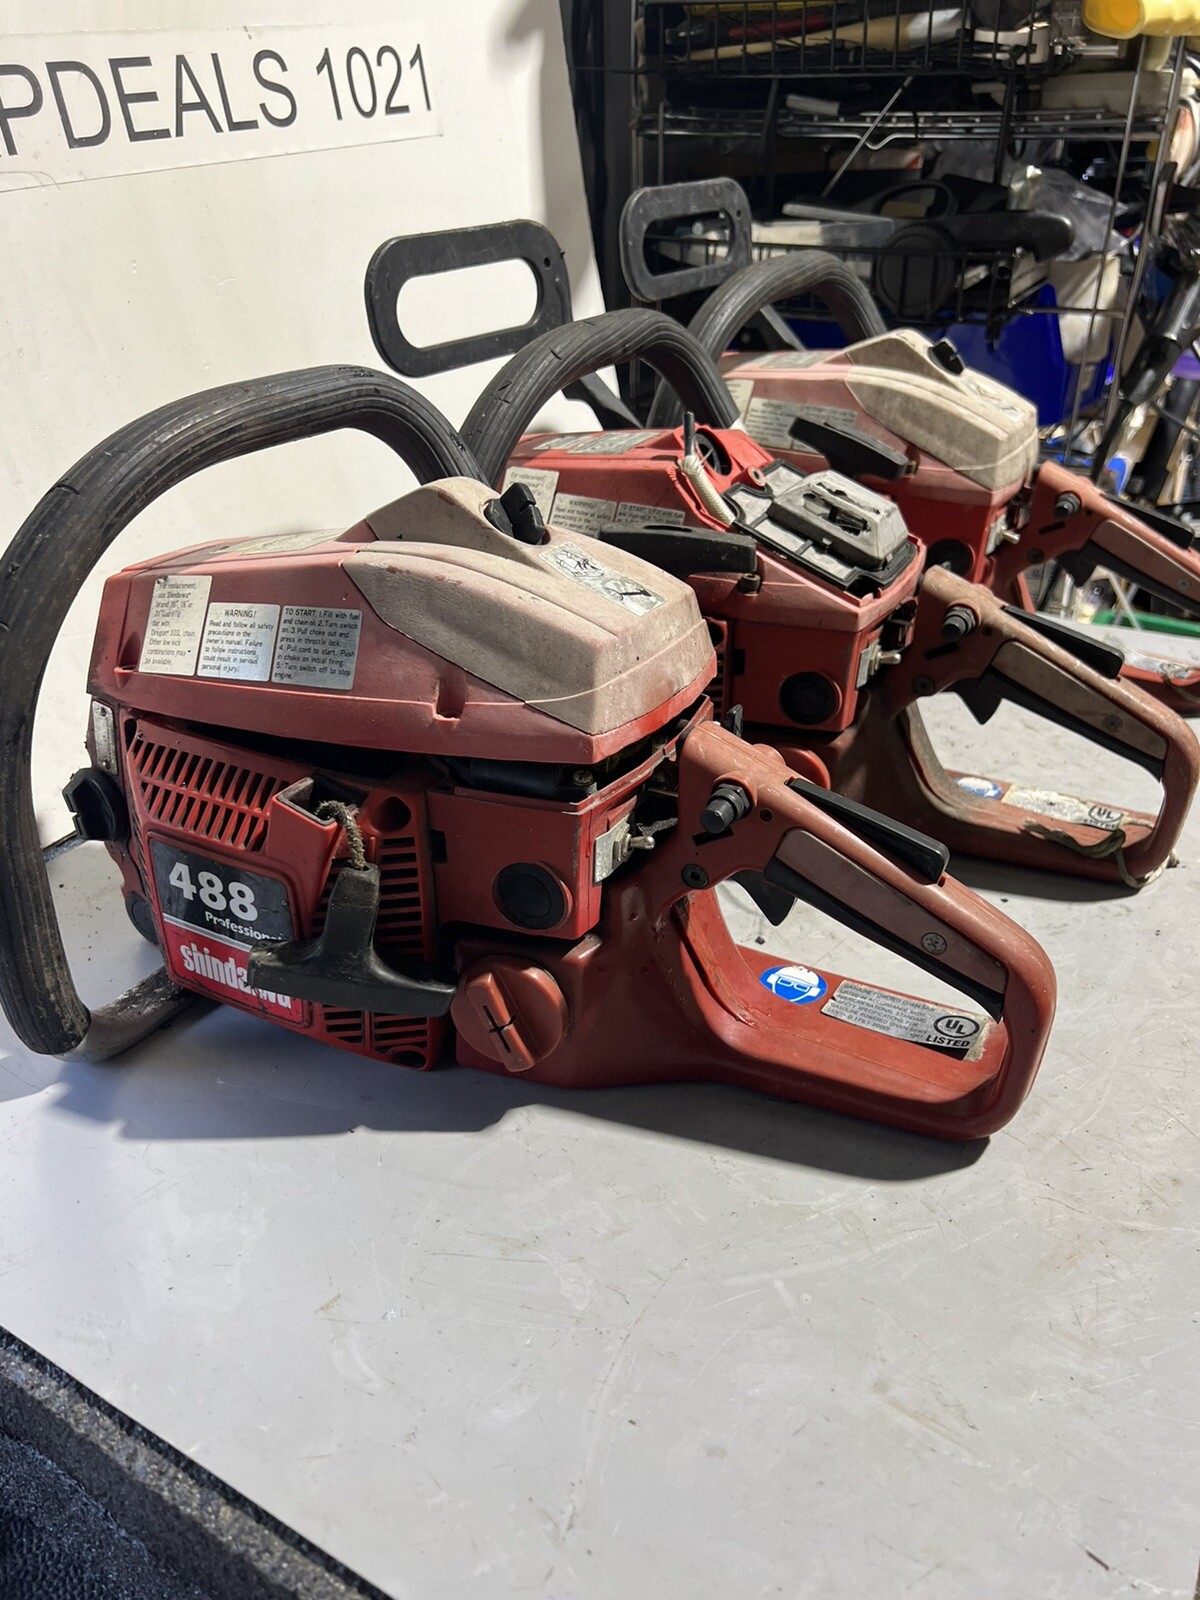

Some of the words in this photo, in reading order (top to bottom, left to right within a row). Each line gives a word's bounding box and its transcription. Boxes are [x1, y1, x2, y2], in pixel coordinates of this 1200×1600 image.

[0, 49, 298, 157] PDEALS
[316, 43, 431, 122] 1021
[224, 609, 257, 618] WARNING!
[258, 623, 274, 631] safety
[340, 649, 355, 658] Push
[168, 861, 258, 922] 488
[204, 910, 283, 941] Profession
[179, 942, 292, 1010] shinda
[945, 1017, 966, 1035] UL
[925, 1034, 970, 1047] LISTED
